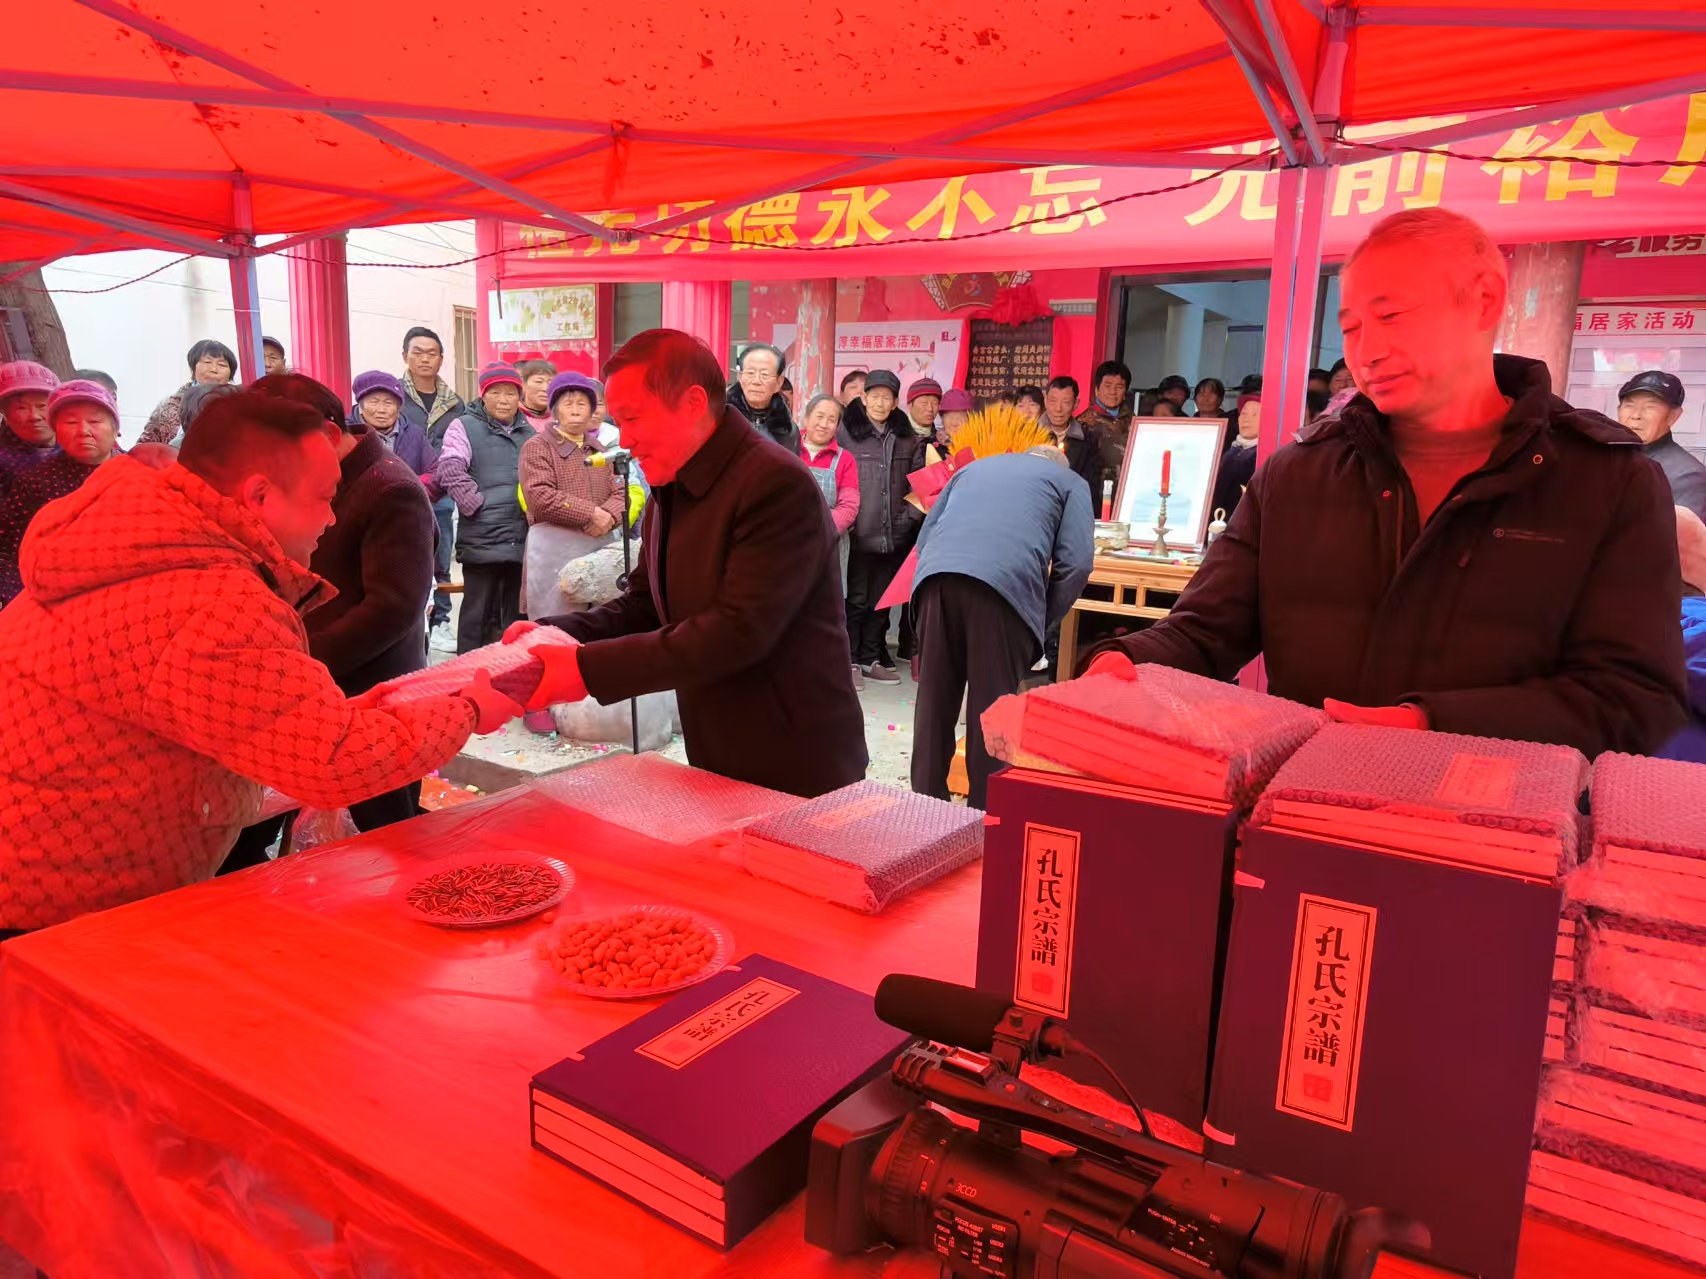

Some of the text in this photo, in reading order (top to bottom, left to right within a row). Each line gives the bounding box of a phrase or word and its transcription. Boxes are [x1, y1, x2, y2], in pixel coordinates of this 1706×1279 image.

[1031, 848, 1064, 967] 孔氏宗譜
[1303, 924, 1351, 1067] 孔氏宗譜
[956, 1182, 977, 1197] 3CCD
